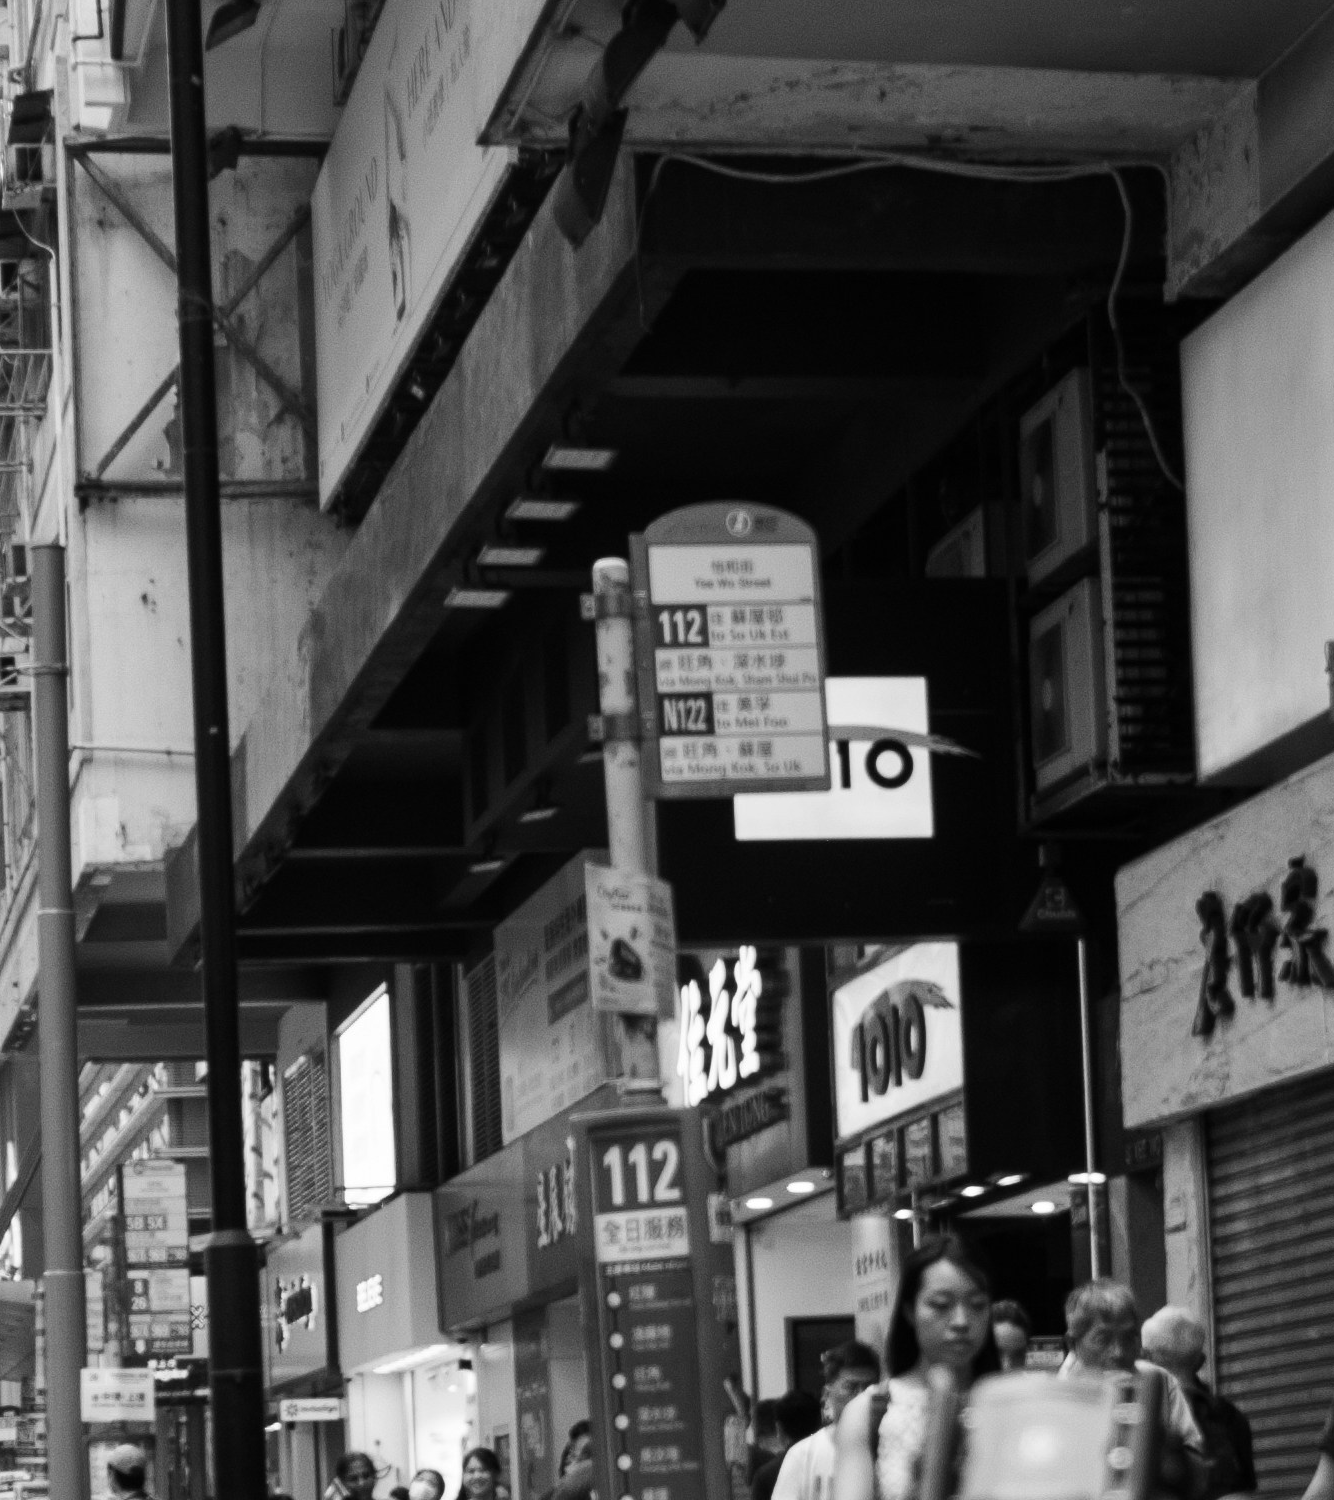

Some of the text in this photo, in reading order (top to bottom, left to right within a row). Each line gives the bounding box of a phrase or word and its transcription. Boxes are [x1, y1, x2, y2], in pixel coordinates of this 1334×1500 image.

[658, 609, 702, 644] 112
[663, 698, 708, 732] N122
[850, 991, 928, 1103] 1010
[602, 1138, 682, 1207] 112
[603, 1215, 685, 1245] 全日服務
